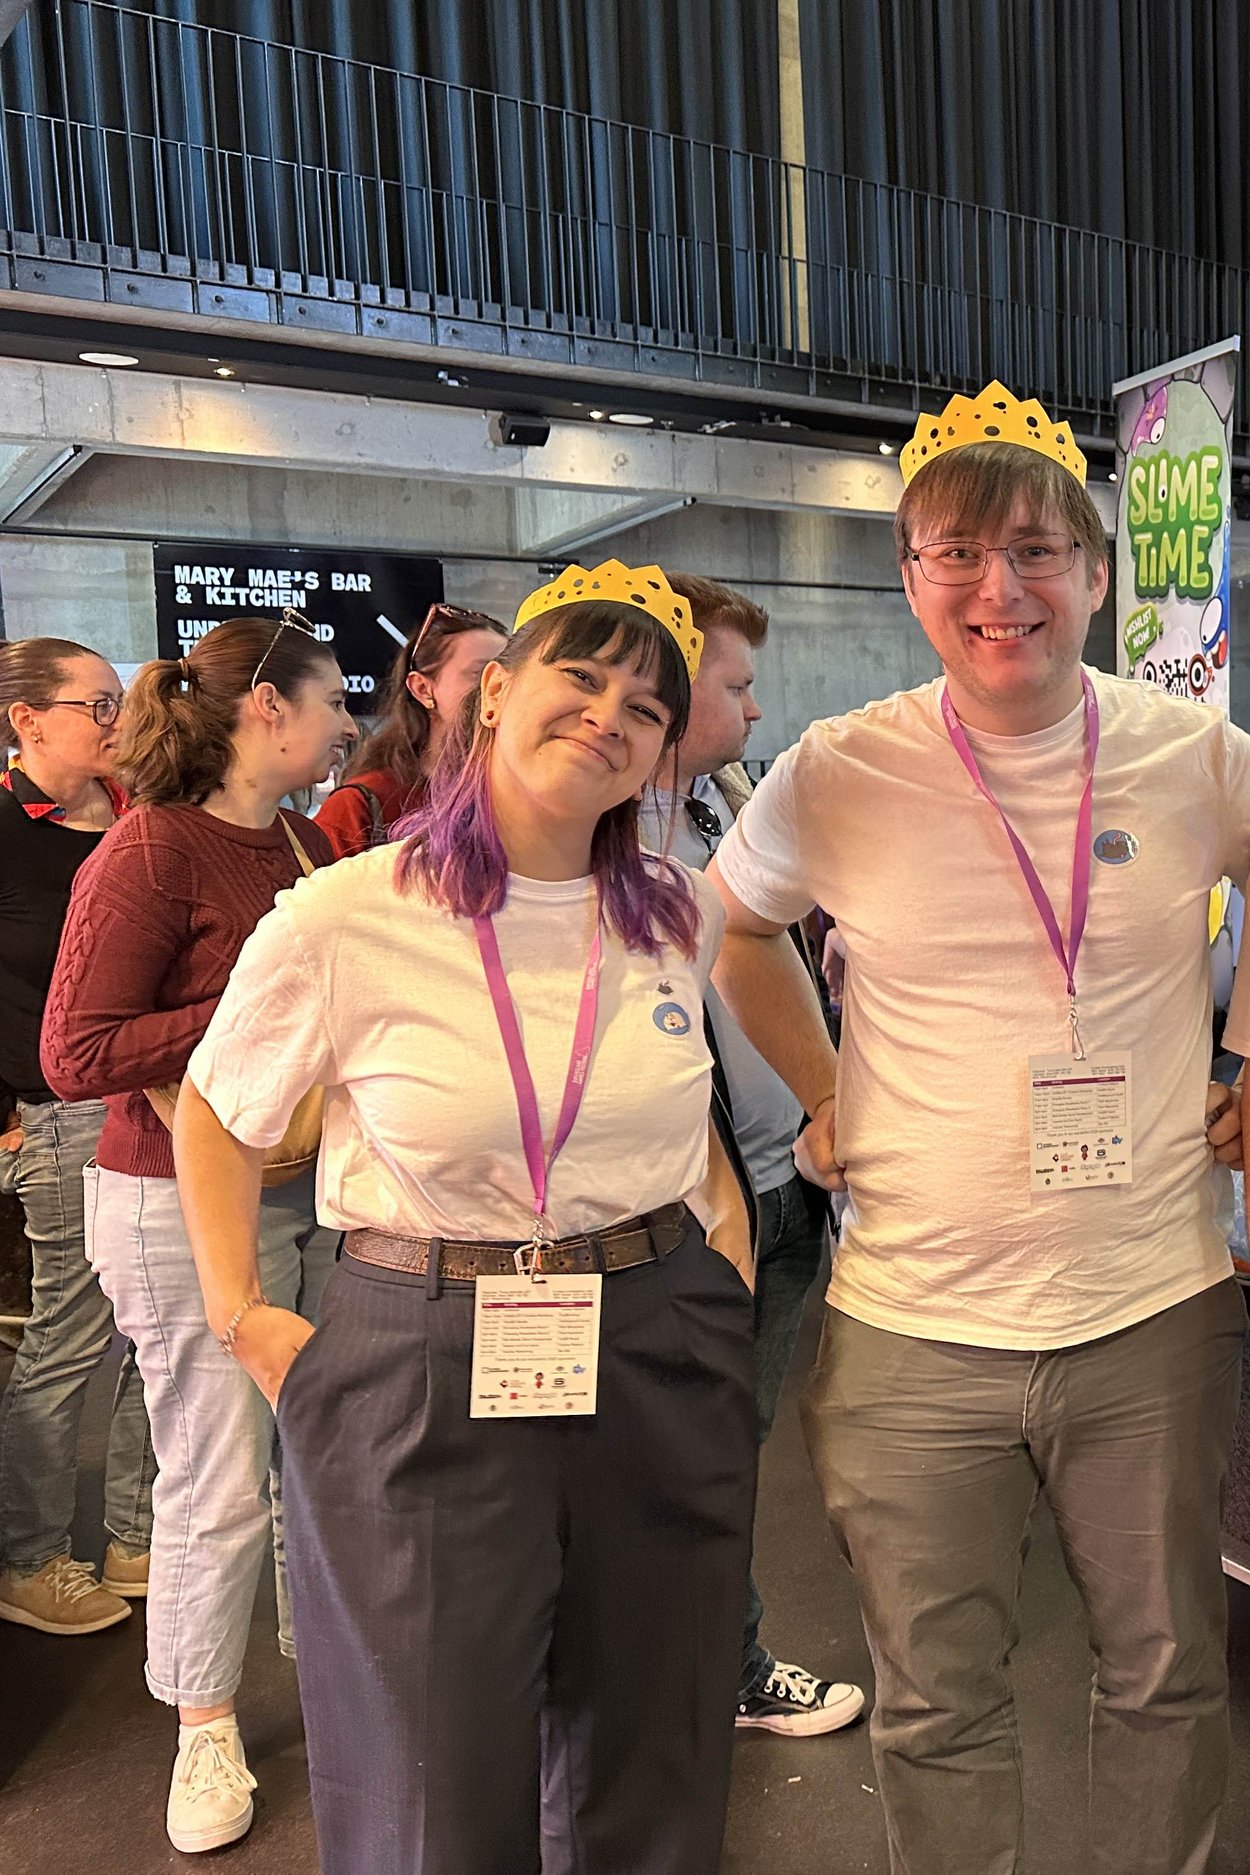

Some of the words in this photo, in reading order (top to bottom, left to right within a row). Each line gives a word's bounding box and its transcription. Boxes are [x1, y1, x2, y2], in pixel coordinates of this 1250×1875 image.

[1130, 455, 1219, 525] SLIME
[174, 565, 235, 586] MARY
[248, 568, 320, 591] MAE'S
[331, 572, 372, 592] BAR
[175, 585, 193, 605] &
[205, 587, 306, 608] KITCHEN
